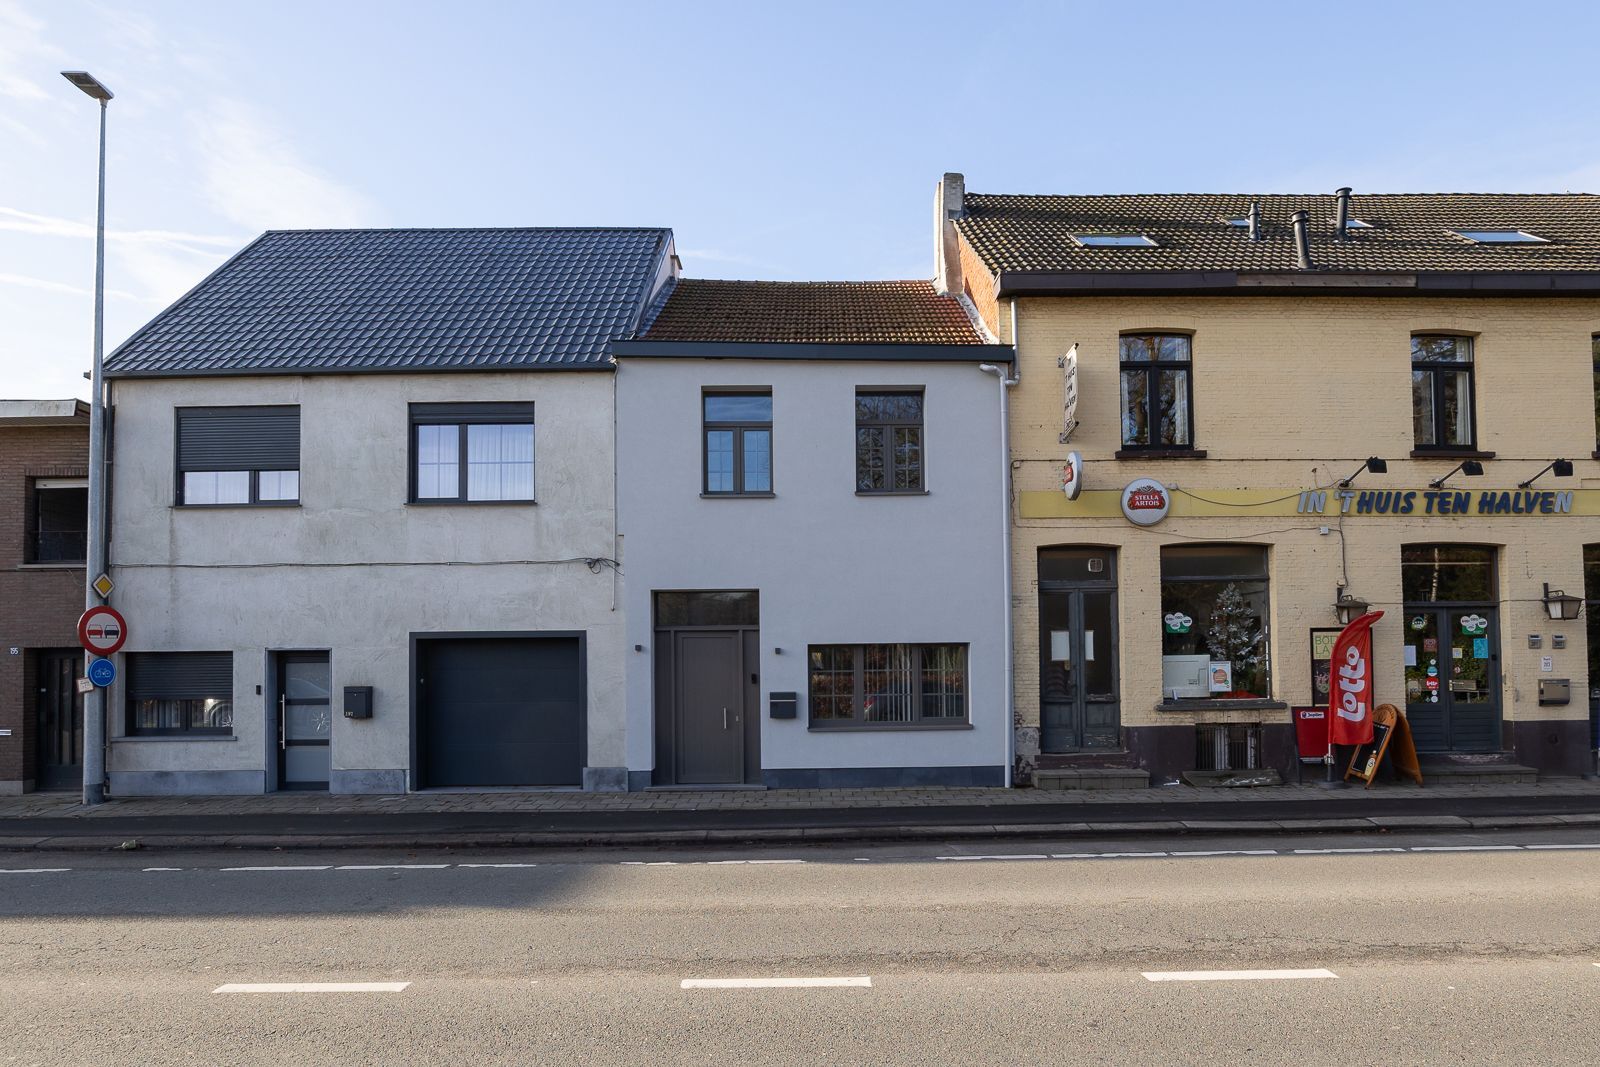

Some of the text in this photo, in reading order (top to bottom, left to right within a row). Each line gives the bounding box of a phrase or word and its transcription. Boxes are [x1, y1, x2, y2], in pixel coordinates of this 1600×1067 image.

[1297, 491, 1326, 513] IN
[1357, 491, 1416, 514] HUIS
[1423, 491, 1471, 514] TEN
[1478, 491, 1573, 514] HALVEN
[1337, 645, 1366, 722] Lotto
